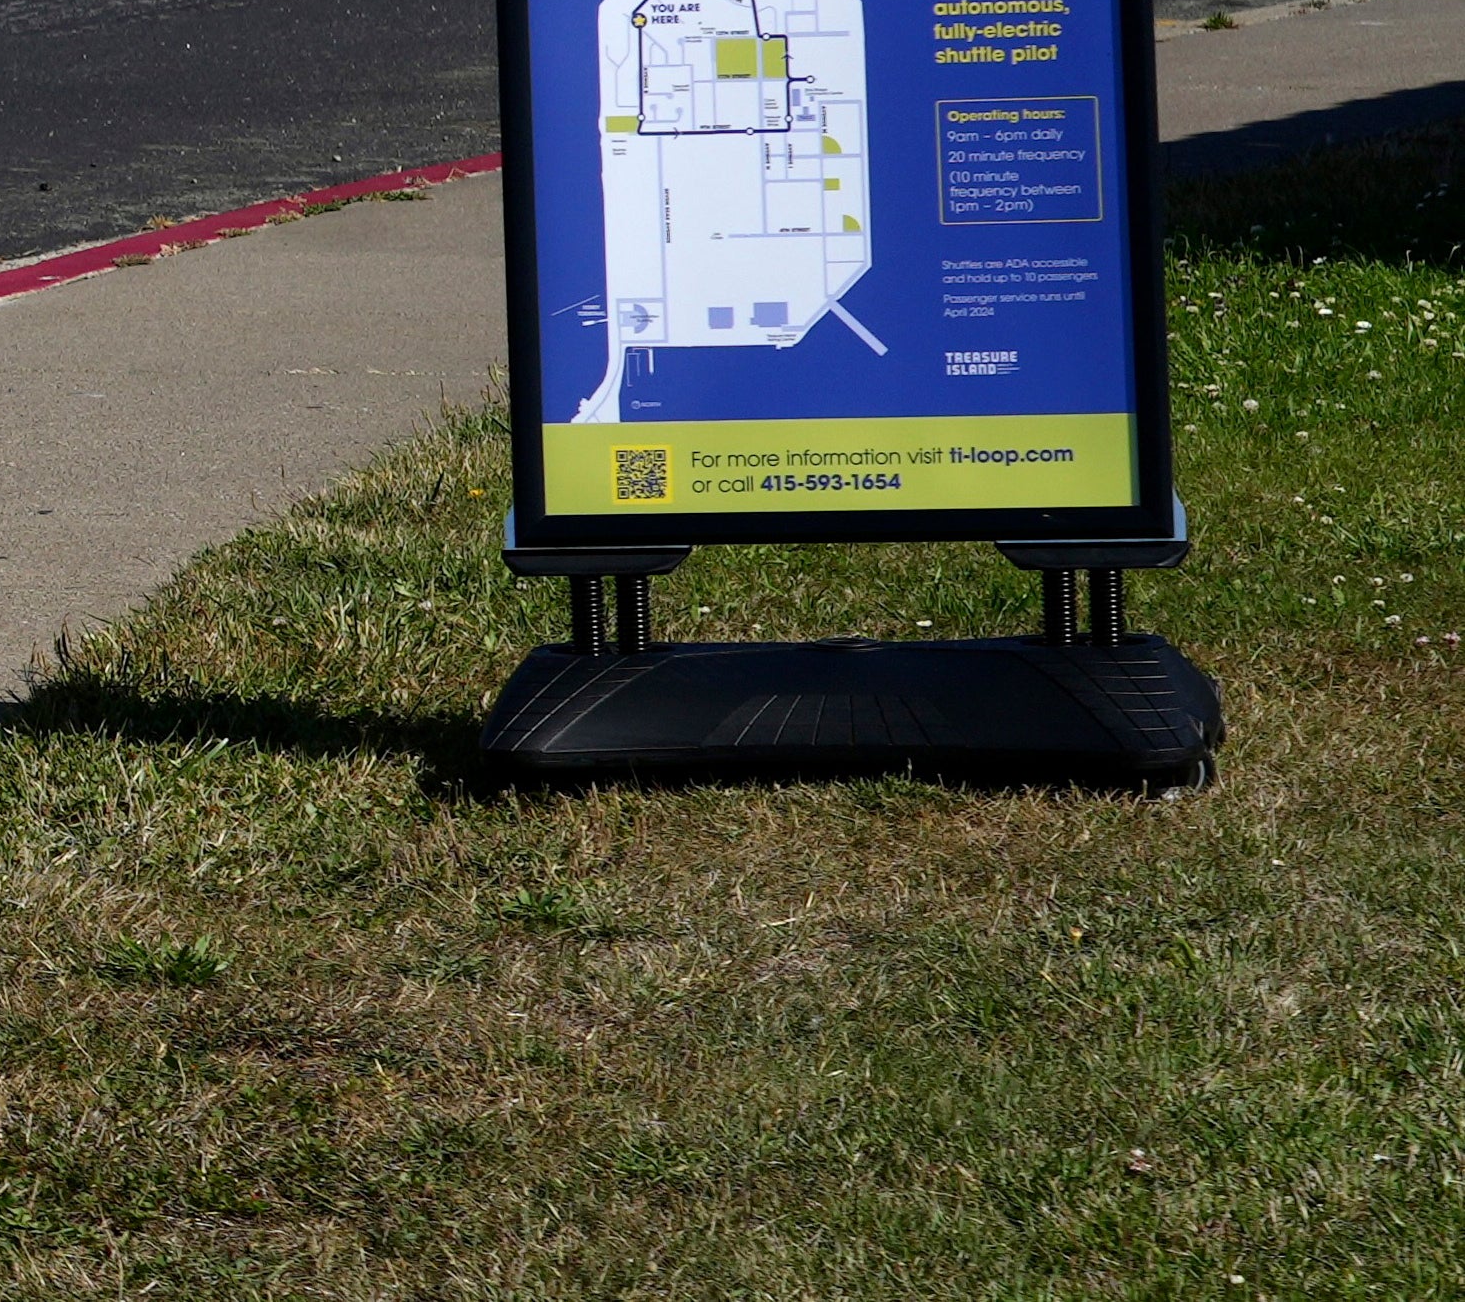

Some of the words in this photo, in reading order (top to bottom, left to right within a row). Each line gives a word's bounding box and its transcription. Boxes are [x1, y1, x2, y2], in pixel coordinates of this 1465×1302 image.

[651, 3, 675, 13] YOU
[679, 3, 701, 13] ARE
[933, 20, 1063, 42] fully-electric
[935, 45, 1006, 64] shuttle
[1011, 44, 1059, 66] pilot
[947, 109, 1020, 123] Operating
[1022, 108, 1066, 120] hours:
[947, 130, 980, 143] 9am
[994, 130, 1028, 144] 6pm
[1031, 128, 1064, 142] daily
[948, 150, 966, 163] 20
[968, 149, 1015, 163] minute
[1017, 148, 1086, 163] frequency
[949, 170, 971, 184] (10
[973, 170, 1020, 182] minute
[949, 185, 1019, 200] frequency
[1020, 183, 1082, 196] between
[949, 199, 980, 214] 1pm
[995, 198, 1035, 214] 2pm)
[942, 259, 983, 270] Shuttles
[984, 261, 1003, 270] are
[1005, 258, 1030, 269] ADA
[1031, 257, 1089, 269] accessible
[942, 273, 965, 284] and
[967, 272, 992, 283] hold
[993, 274, 1009, 285] up
[1010, 273, 1023, 283] to
[1024, 272, 1037, 282] 10
[1038, 271, 1099, 283] passengers
[943, 293, 998, 305] Passenger
[999, 292, 1038, 303] service
[1063, 291, 1086, 301] until
[943, 306, 968, 318] April
[969, 306, 995, 317] 2024
[945, 350, 1019, 364] TREASURE
[946, 363, 998, 376] ISLAND
[691, 450, 723, 469] For
[727, 452, 780, 468] more
[785, 448, 902, 467] information
[905, 446, 944, 465] visit
[948, 445, 1075, 468] ti-loop.com
[691, 478, 714, 495] or
[717, 475, 755, 494] call
[760, 472, 902, 493] 415-593-1654
